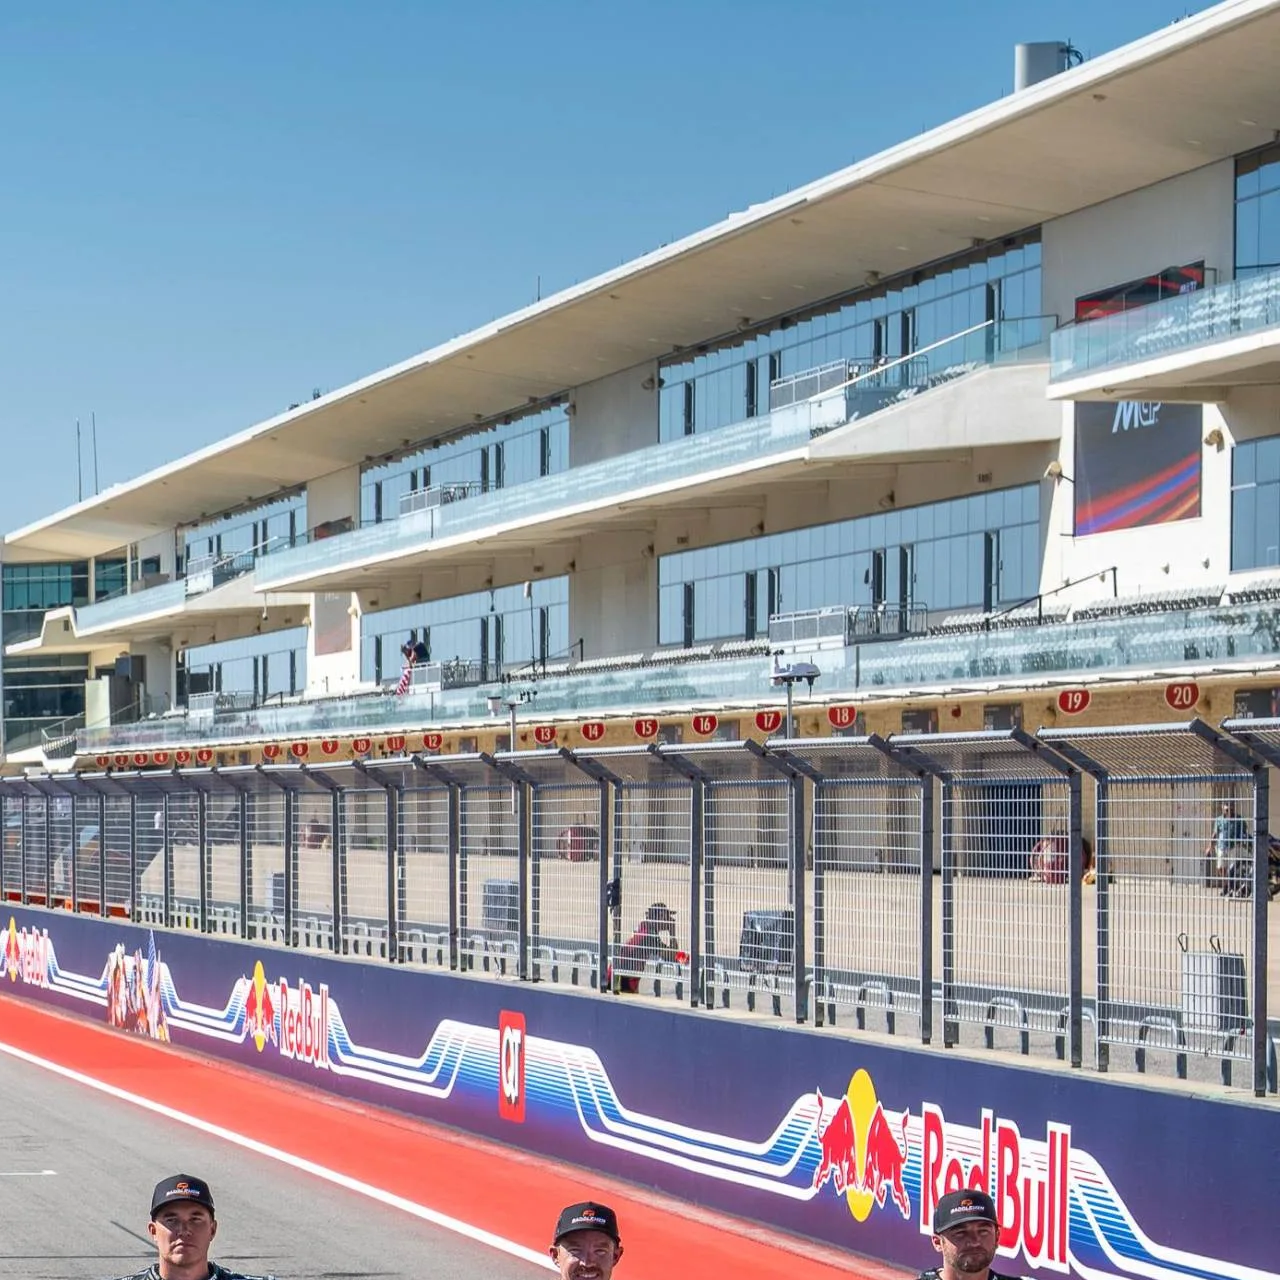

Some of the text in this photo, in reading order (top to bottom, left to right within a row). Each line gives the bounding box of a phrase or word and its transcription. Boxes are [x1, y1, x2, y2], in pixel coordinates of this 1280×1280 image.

[1068, 693, 1081, 709] 19
[1174, 687, 1191, 705] 20
[763, 714, 773, 728] 17
[836, 709, 849, 723] 18
[588, 725, 598, 737] 14
[641, 721, 652, 734] 15
[700, 719, 710, 732] 16
[540, 728, 550, 740] 13
[358, 740, 366, 750] 10
[392, 738, 400, 748] 11
[429, 736, 437, 747] 12
[279, 977, 330, 1069] Red Bull
[501, 1026, 522, 1104] QT
[996, 1125, 1070, 1265] Bull
[950, 1205, 985, 1215] SADDLEMEN
[571, 1216, 606, 1224] SADDLEMEN
